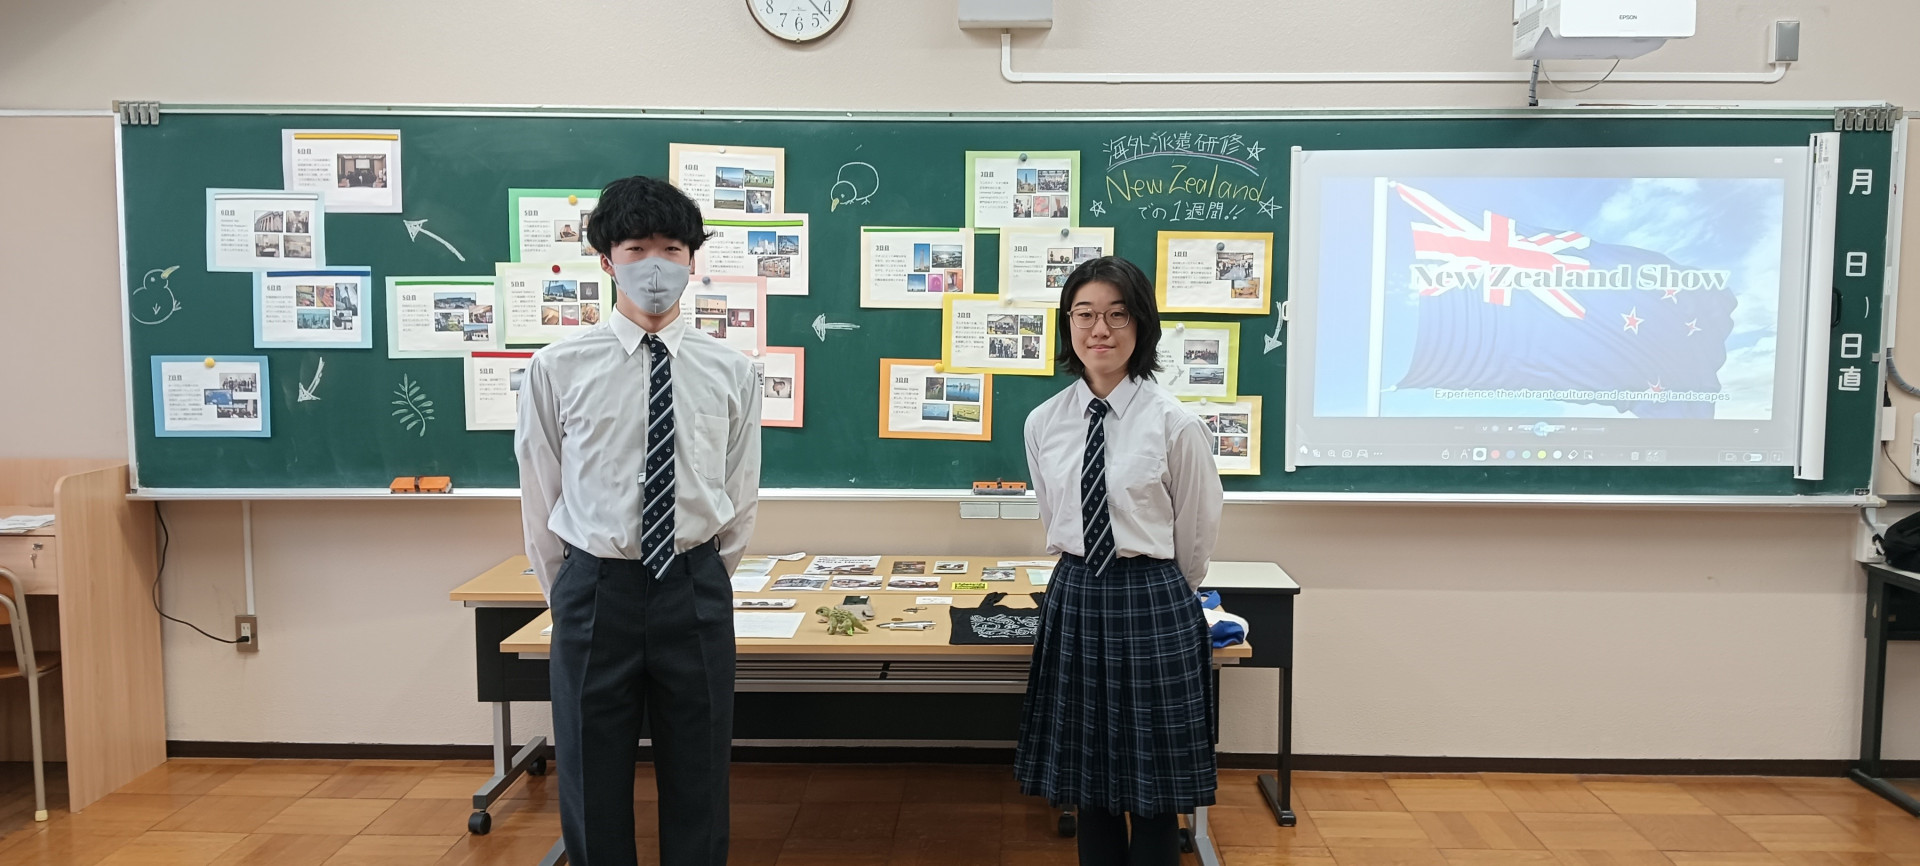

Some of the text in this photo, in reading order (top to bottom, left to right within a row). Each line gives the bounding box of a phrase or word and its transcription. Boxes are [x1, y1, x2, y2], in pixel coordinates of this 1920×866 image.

[765, 0, 774, 14] 8
[823, 0, 832, 15] 4
[780, 13, 787, 27] 7
[795, 16, 803, 31] 6
[811, 13, 820, 28] 5
[1102, 131, 1245, 166] 海外派遣研修
[1106, 163, 1268, 204] New Zealand
[1849, 168, 1873, 195] 月
[1845, 251, 1867, 277] 日
[1412, 265, 1730, 288] New Zealand Show
[1838, 333, 1862, 391] 日直
[1434, 388, 1731, 402] Experience the vibrant culture and stunning landscapes
